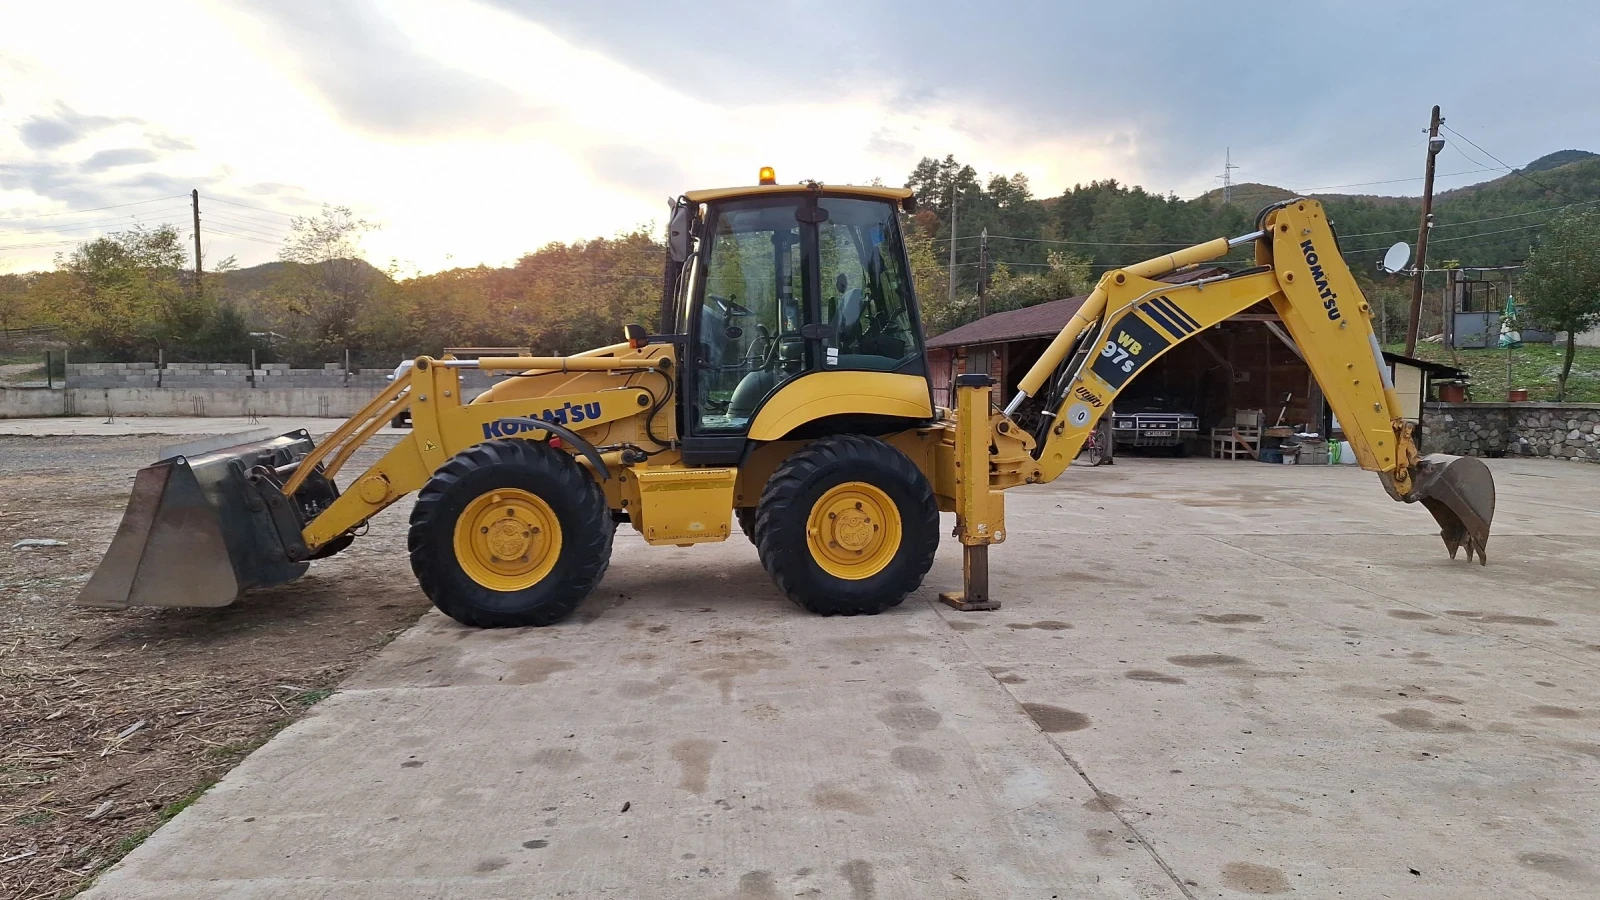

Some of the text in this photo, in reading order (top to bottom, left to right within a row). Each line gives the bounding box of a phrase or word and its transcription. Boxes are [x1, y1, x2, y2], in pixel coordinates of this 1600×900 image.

[1300, 239, 1341, 321] KOMATSU
[1118, 330, 1142, 355] WB
[1076, 386, 1104, 408] Utility
